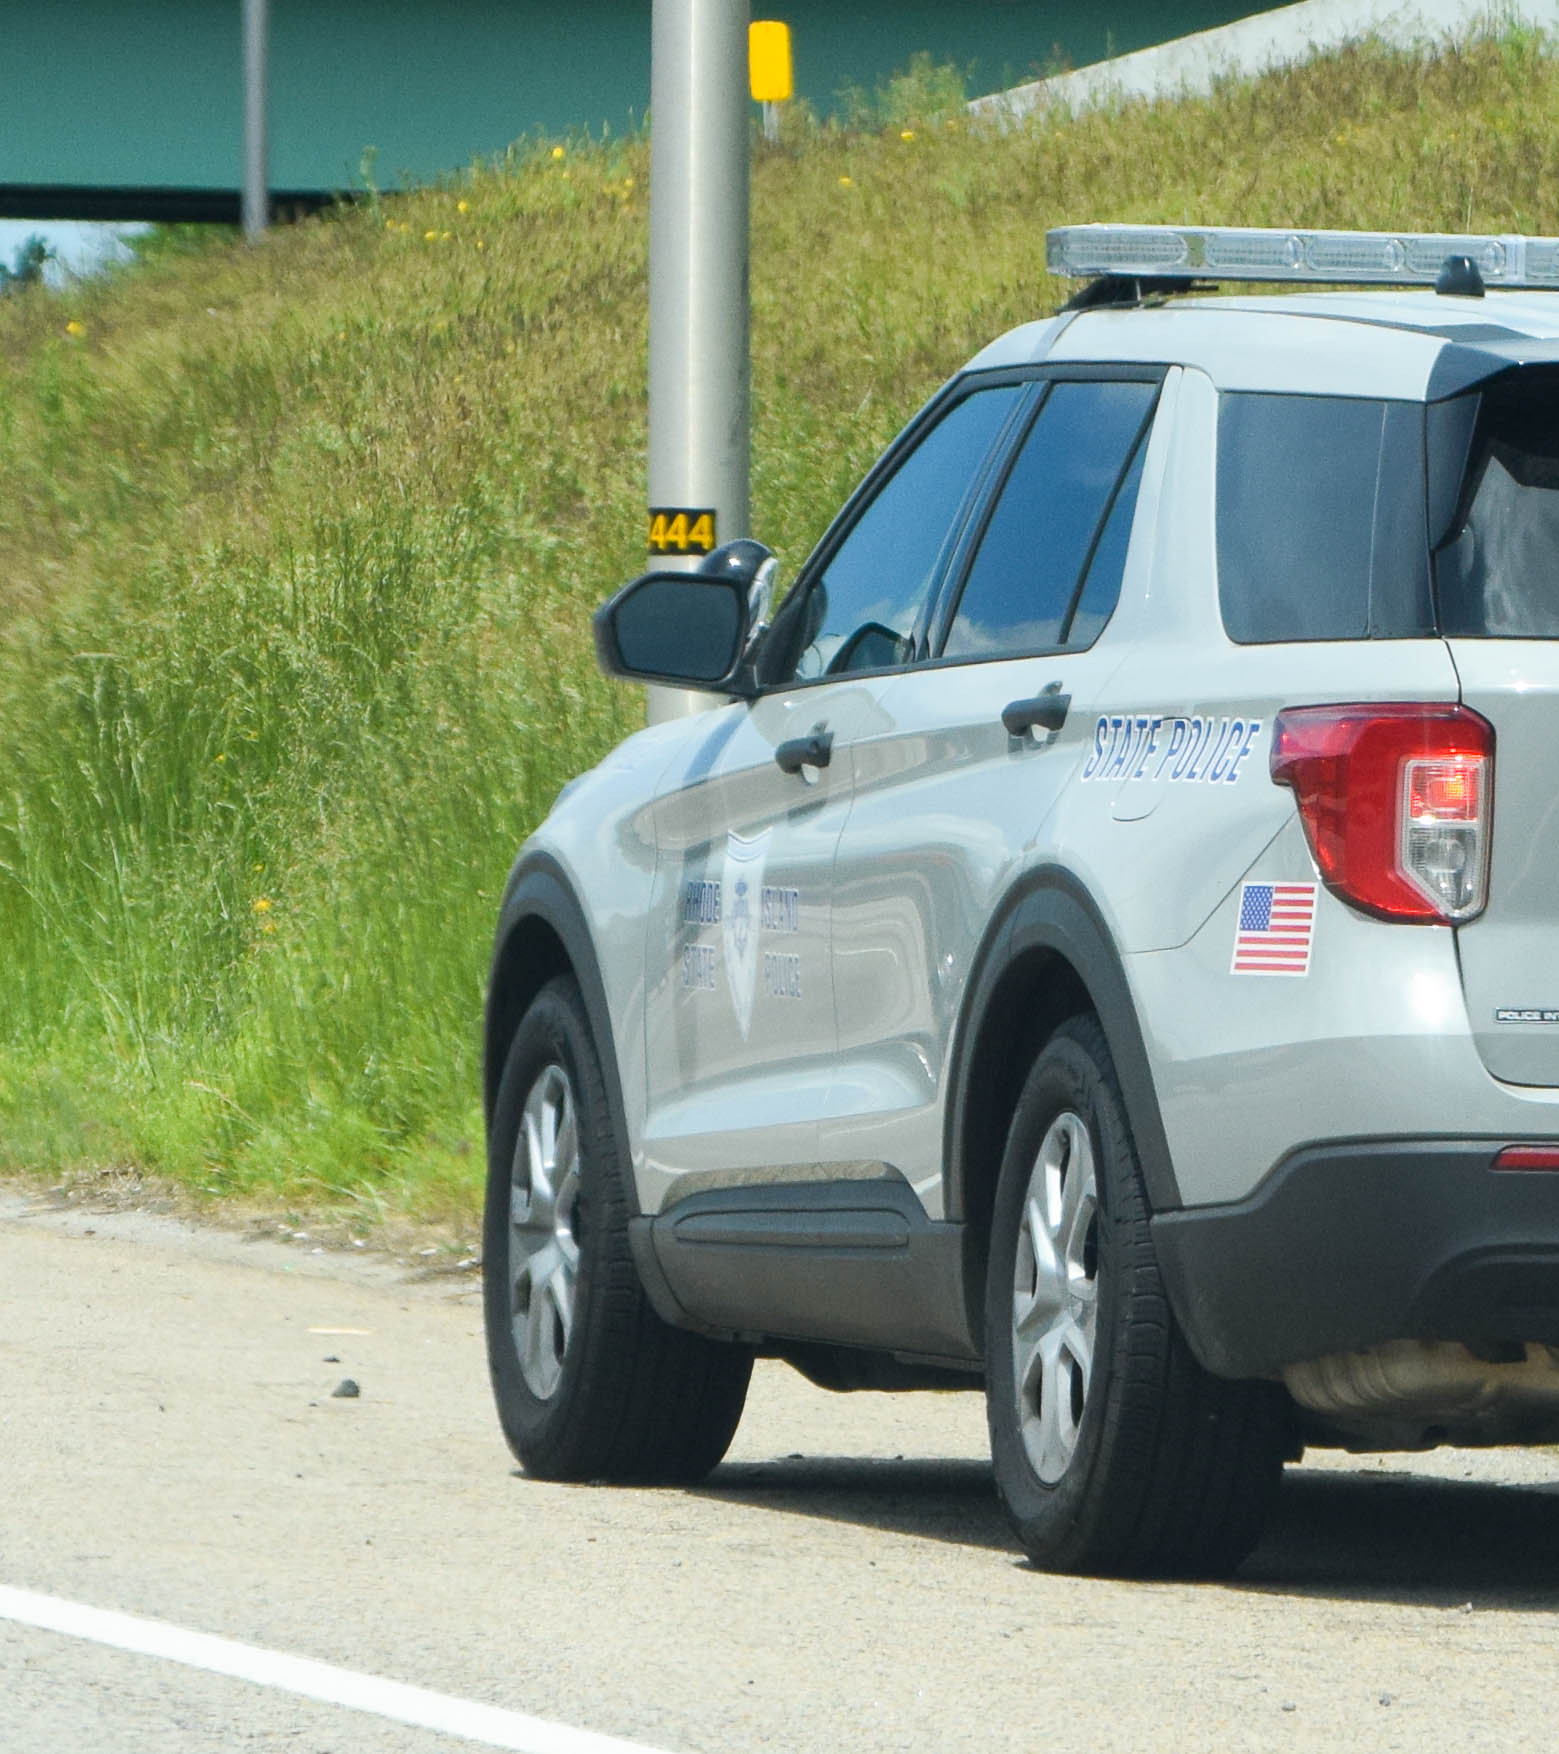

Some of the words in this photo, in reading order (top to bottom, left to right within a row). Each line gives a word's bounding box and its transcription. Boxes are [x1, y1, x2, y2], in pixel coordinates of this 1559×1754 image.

[649, 513, 712, 551] 444
[1083, 717, 1162, 779] STATE
[1154, 720, 1261, 782] POLICE
